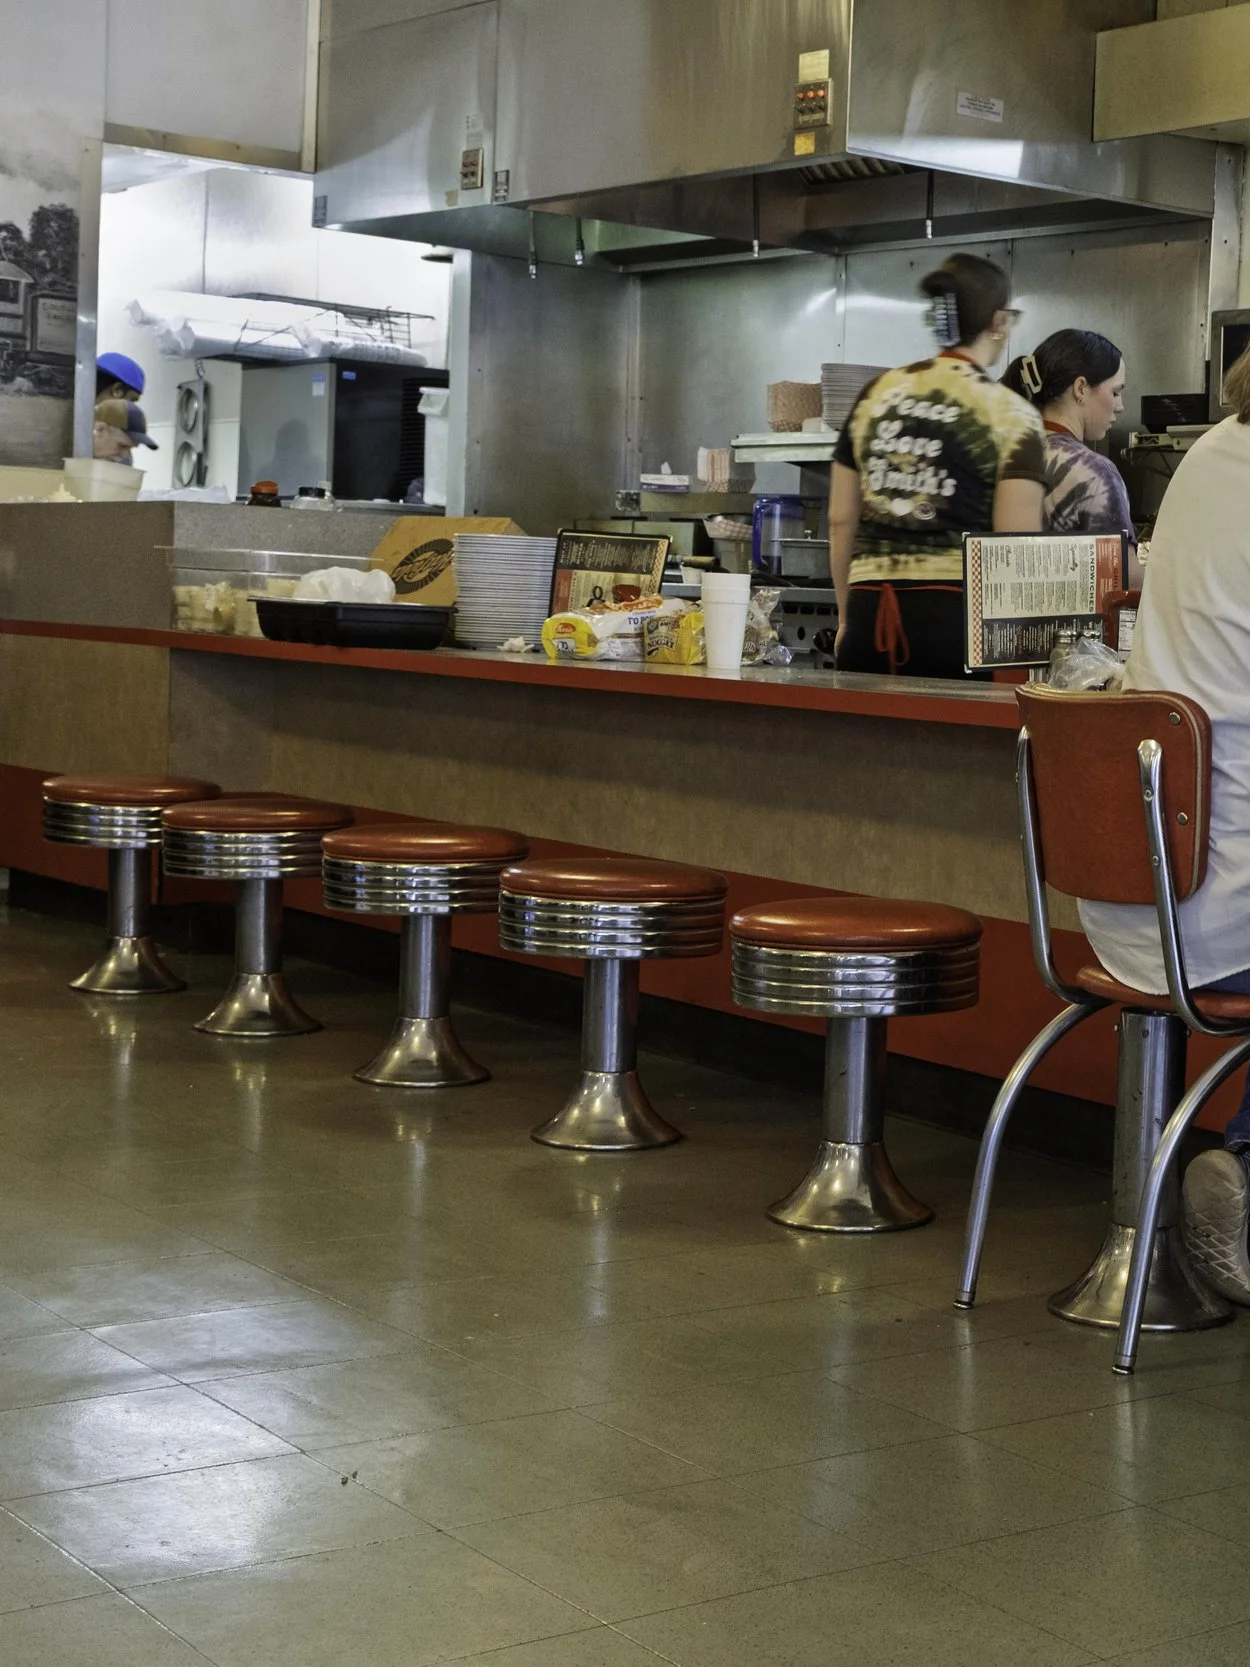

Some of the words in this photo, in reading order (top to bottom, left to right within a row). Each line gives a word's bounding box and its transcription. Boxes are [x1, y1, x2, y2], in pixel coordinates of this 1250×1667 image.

[872, 382, 961, 423] Peace
[869, 419, 943, 457] Love
[867, 456, 957, 495] Smith's
